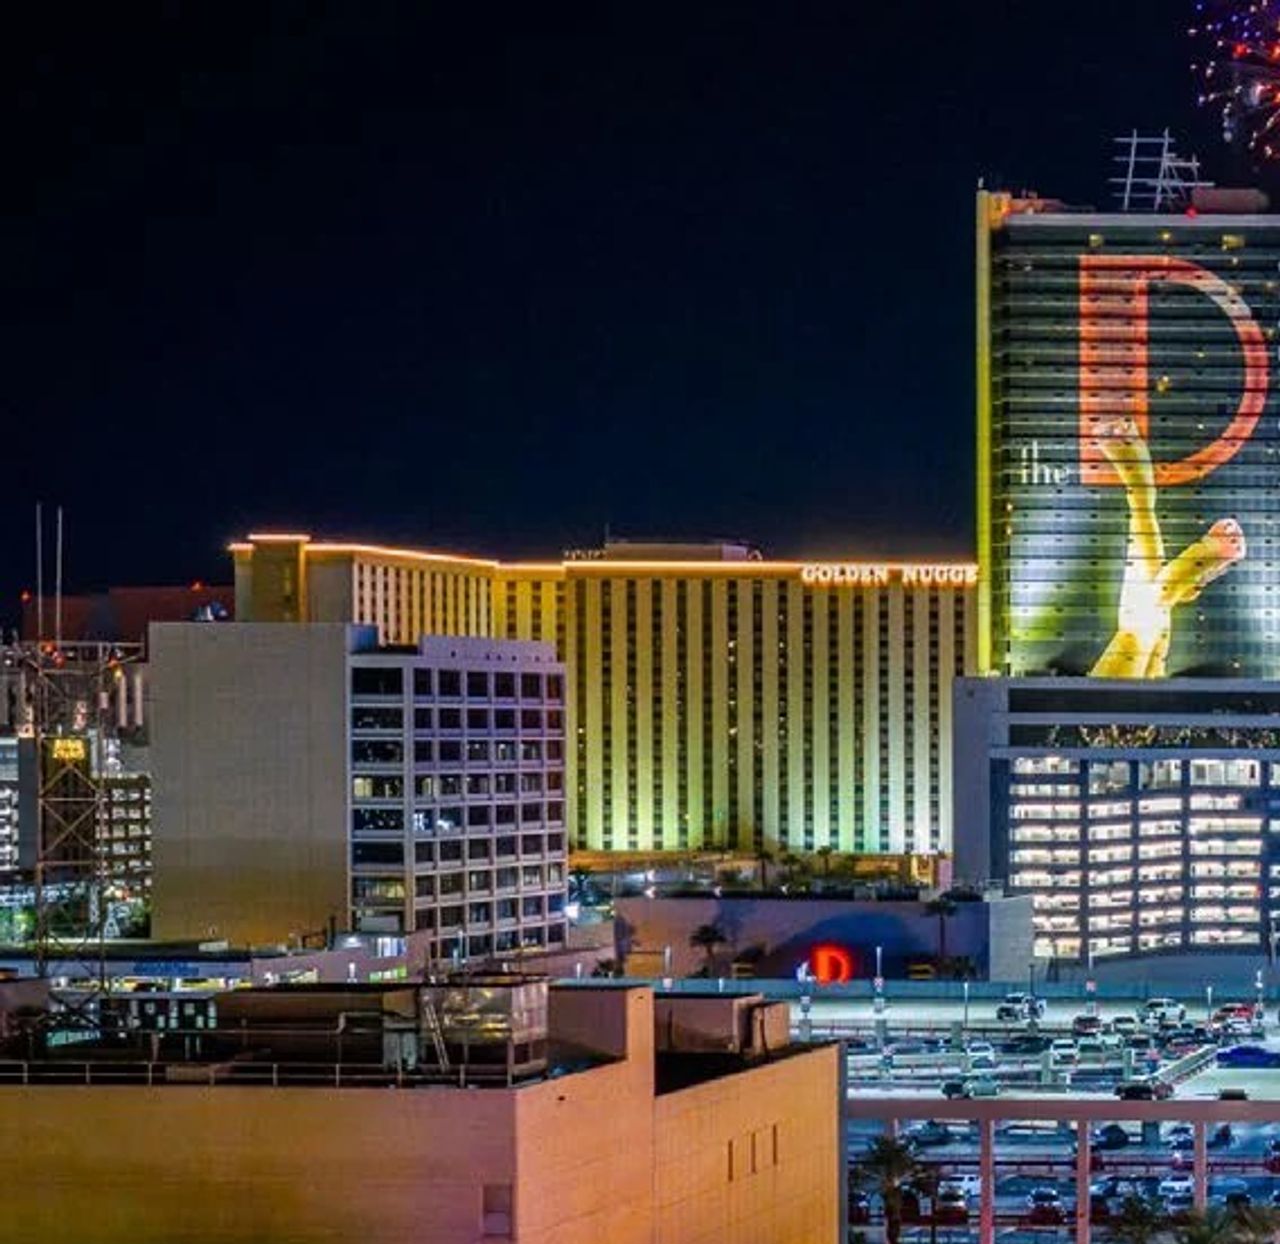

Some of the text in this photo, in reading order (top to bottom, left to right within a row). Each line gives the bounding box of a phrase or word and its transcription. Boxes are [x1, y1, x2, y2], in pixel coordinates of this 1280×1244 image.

[1079, 254, 1270, 486] D
[802, 562, 978, 584] GOLDEN NUGGE
